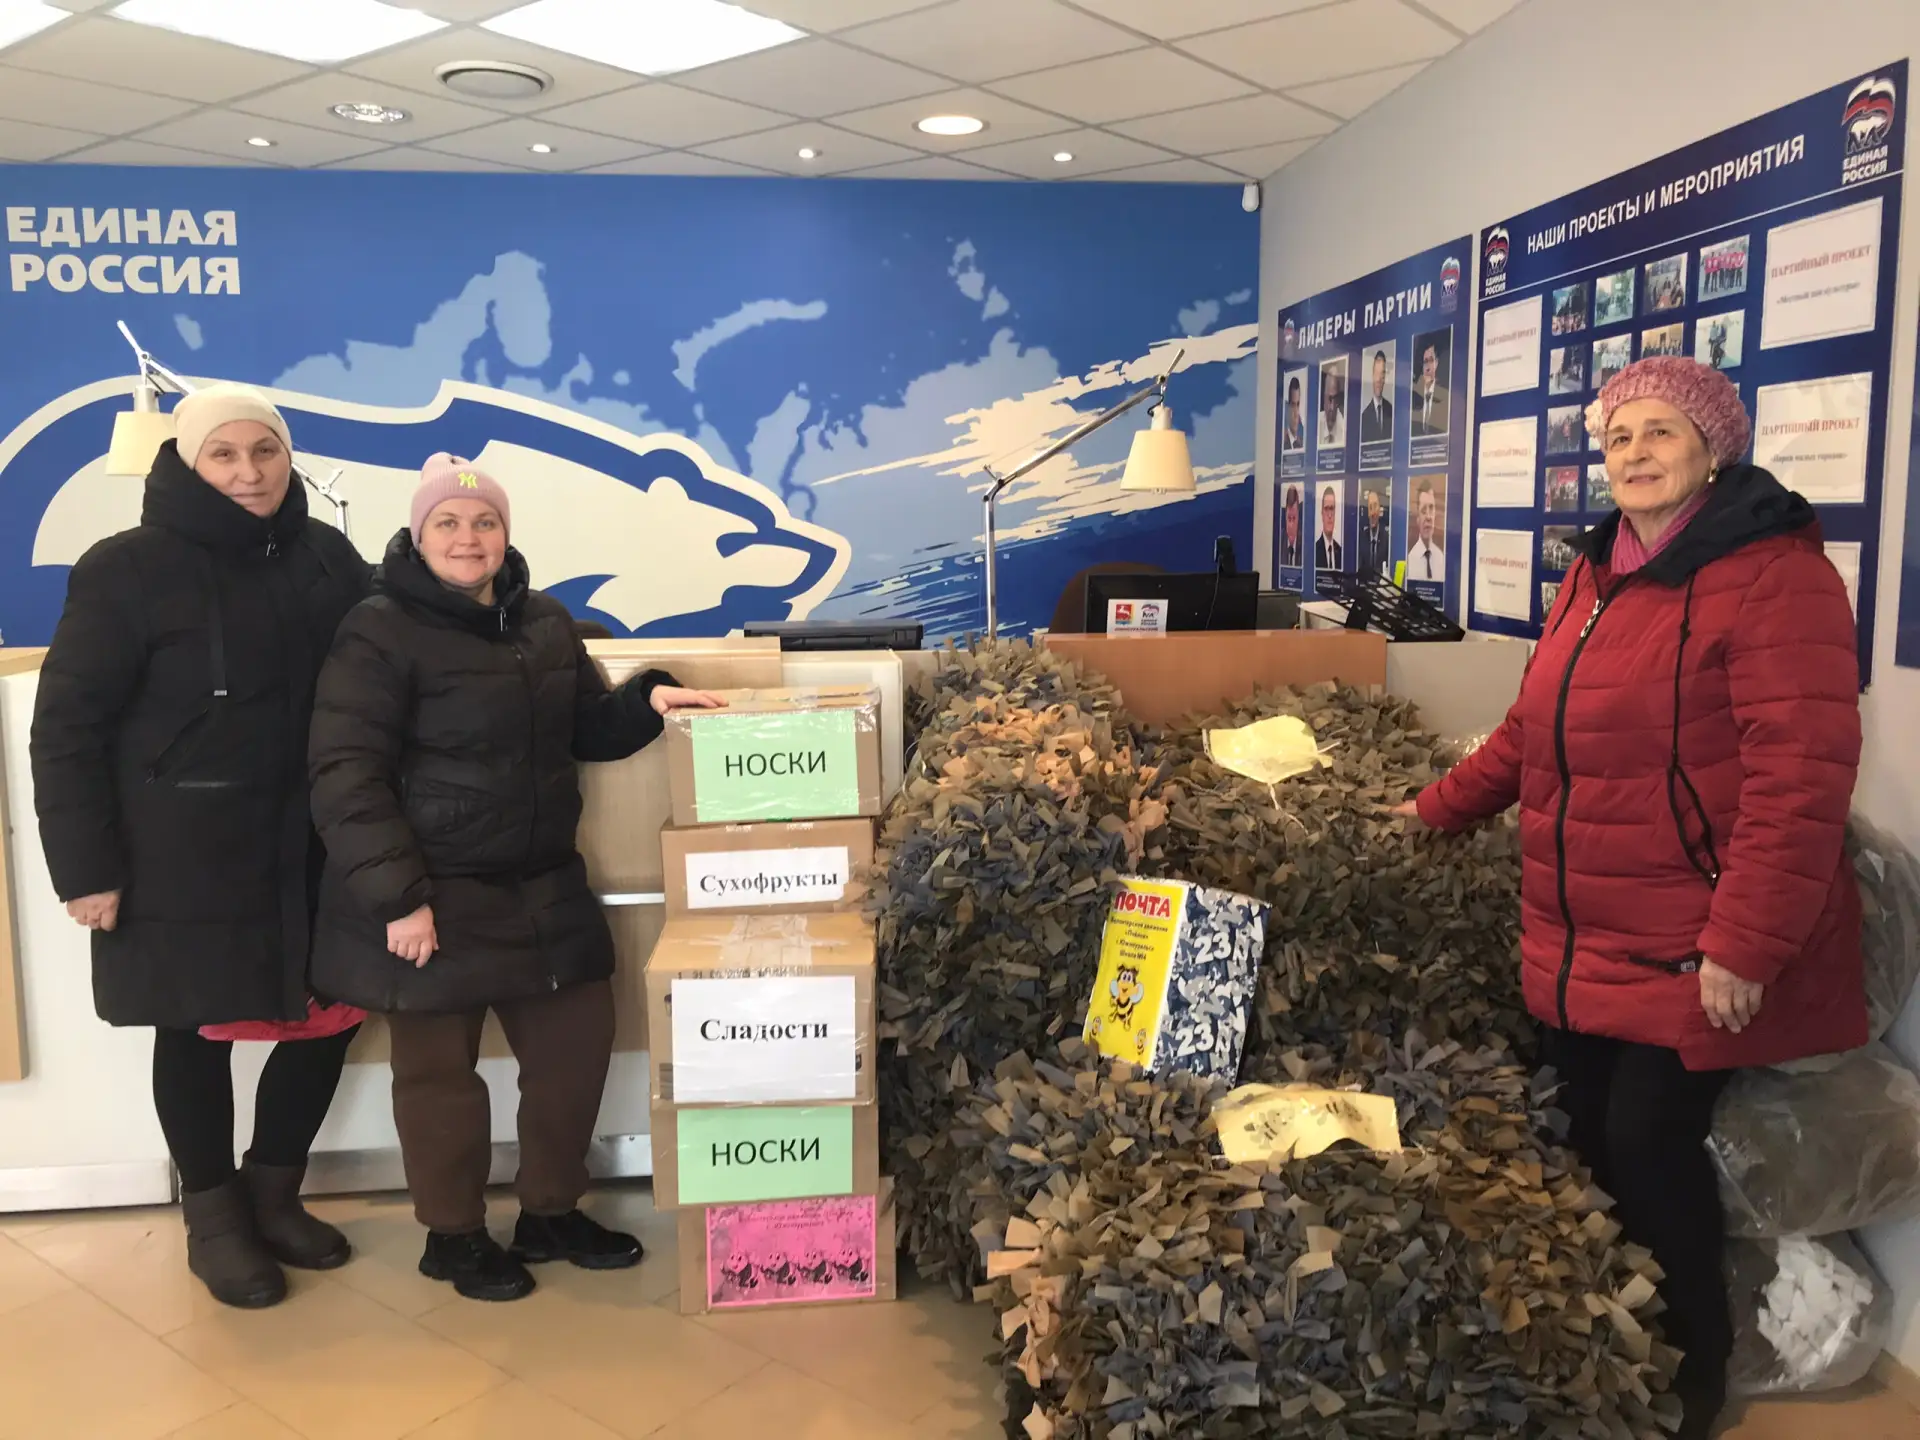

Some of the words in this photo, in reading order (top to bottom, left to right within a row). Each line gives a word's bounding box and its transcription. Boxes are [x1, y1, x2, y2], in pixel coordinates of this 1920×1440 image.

[1842, 160, 1888, 184] РОССИЯ
[1843, 144, 1889, 171] ЕДИНАЯ
[1527, 222, 1566, 256] НАШИ
[1569, 195, 1640, 241] ПРОЕКТЫ
[1644, 188, 1656, 213] И
[1659, 134, 1805, 209] МЕРОПРИЯТИЯ
[6, 206, 238, 248] ЕДИНАЯ
[9, 253, 241, 295] РОССИЯ
[1485, 282, 1506, 296] РОССИЯ
[1297, 309, 1356, 349] ЛИДЕРЫ
[1364, 281, 1432, 327] ПАРТИИ
[725, 750, 827, 778] НОСКИ
[700, 871, 839, 897] Сухофрукты
[1114, 890, 1171, 918] ПОЧТА
[1194, 931, 1232, 964] 23
[700, 1019, 829, 1043] Сладости
[1175, 1022, 1215, 1058] 23
[711, 1136, 821, 1167] НОСКИ
